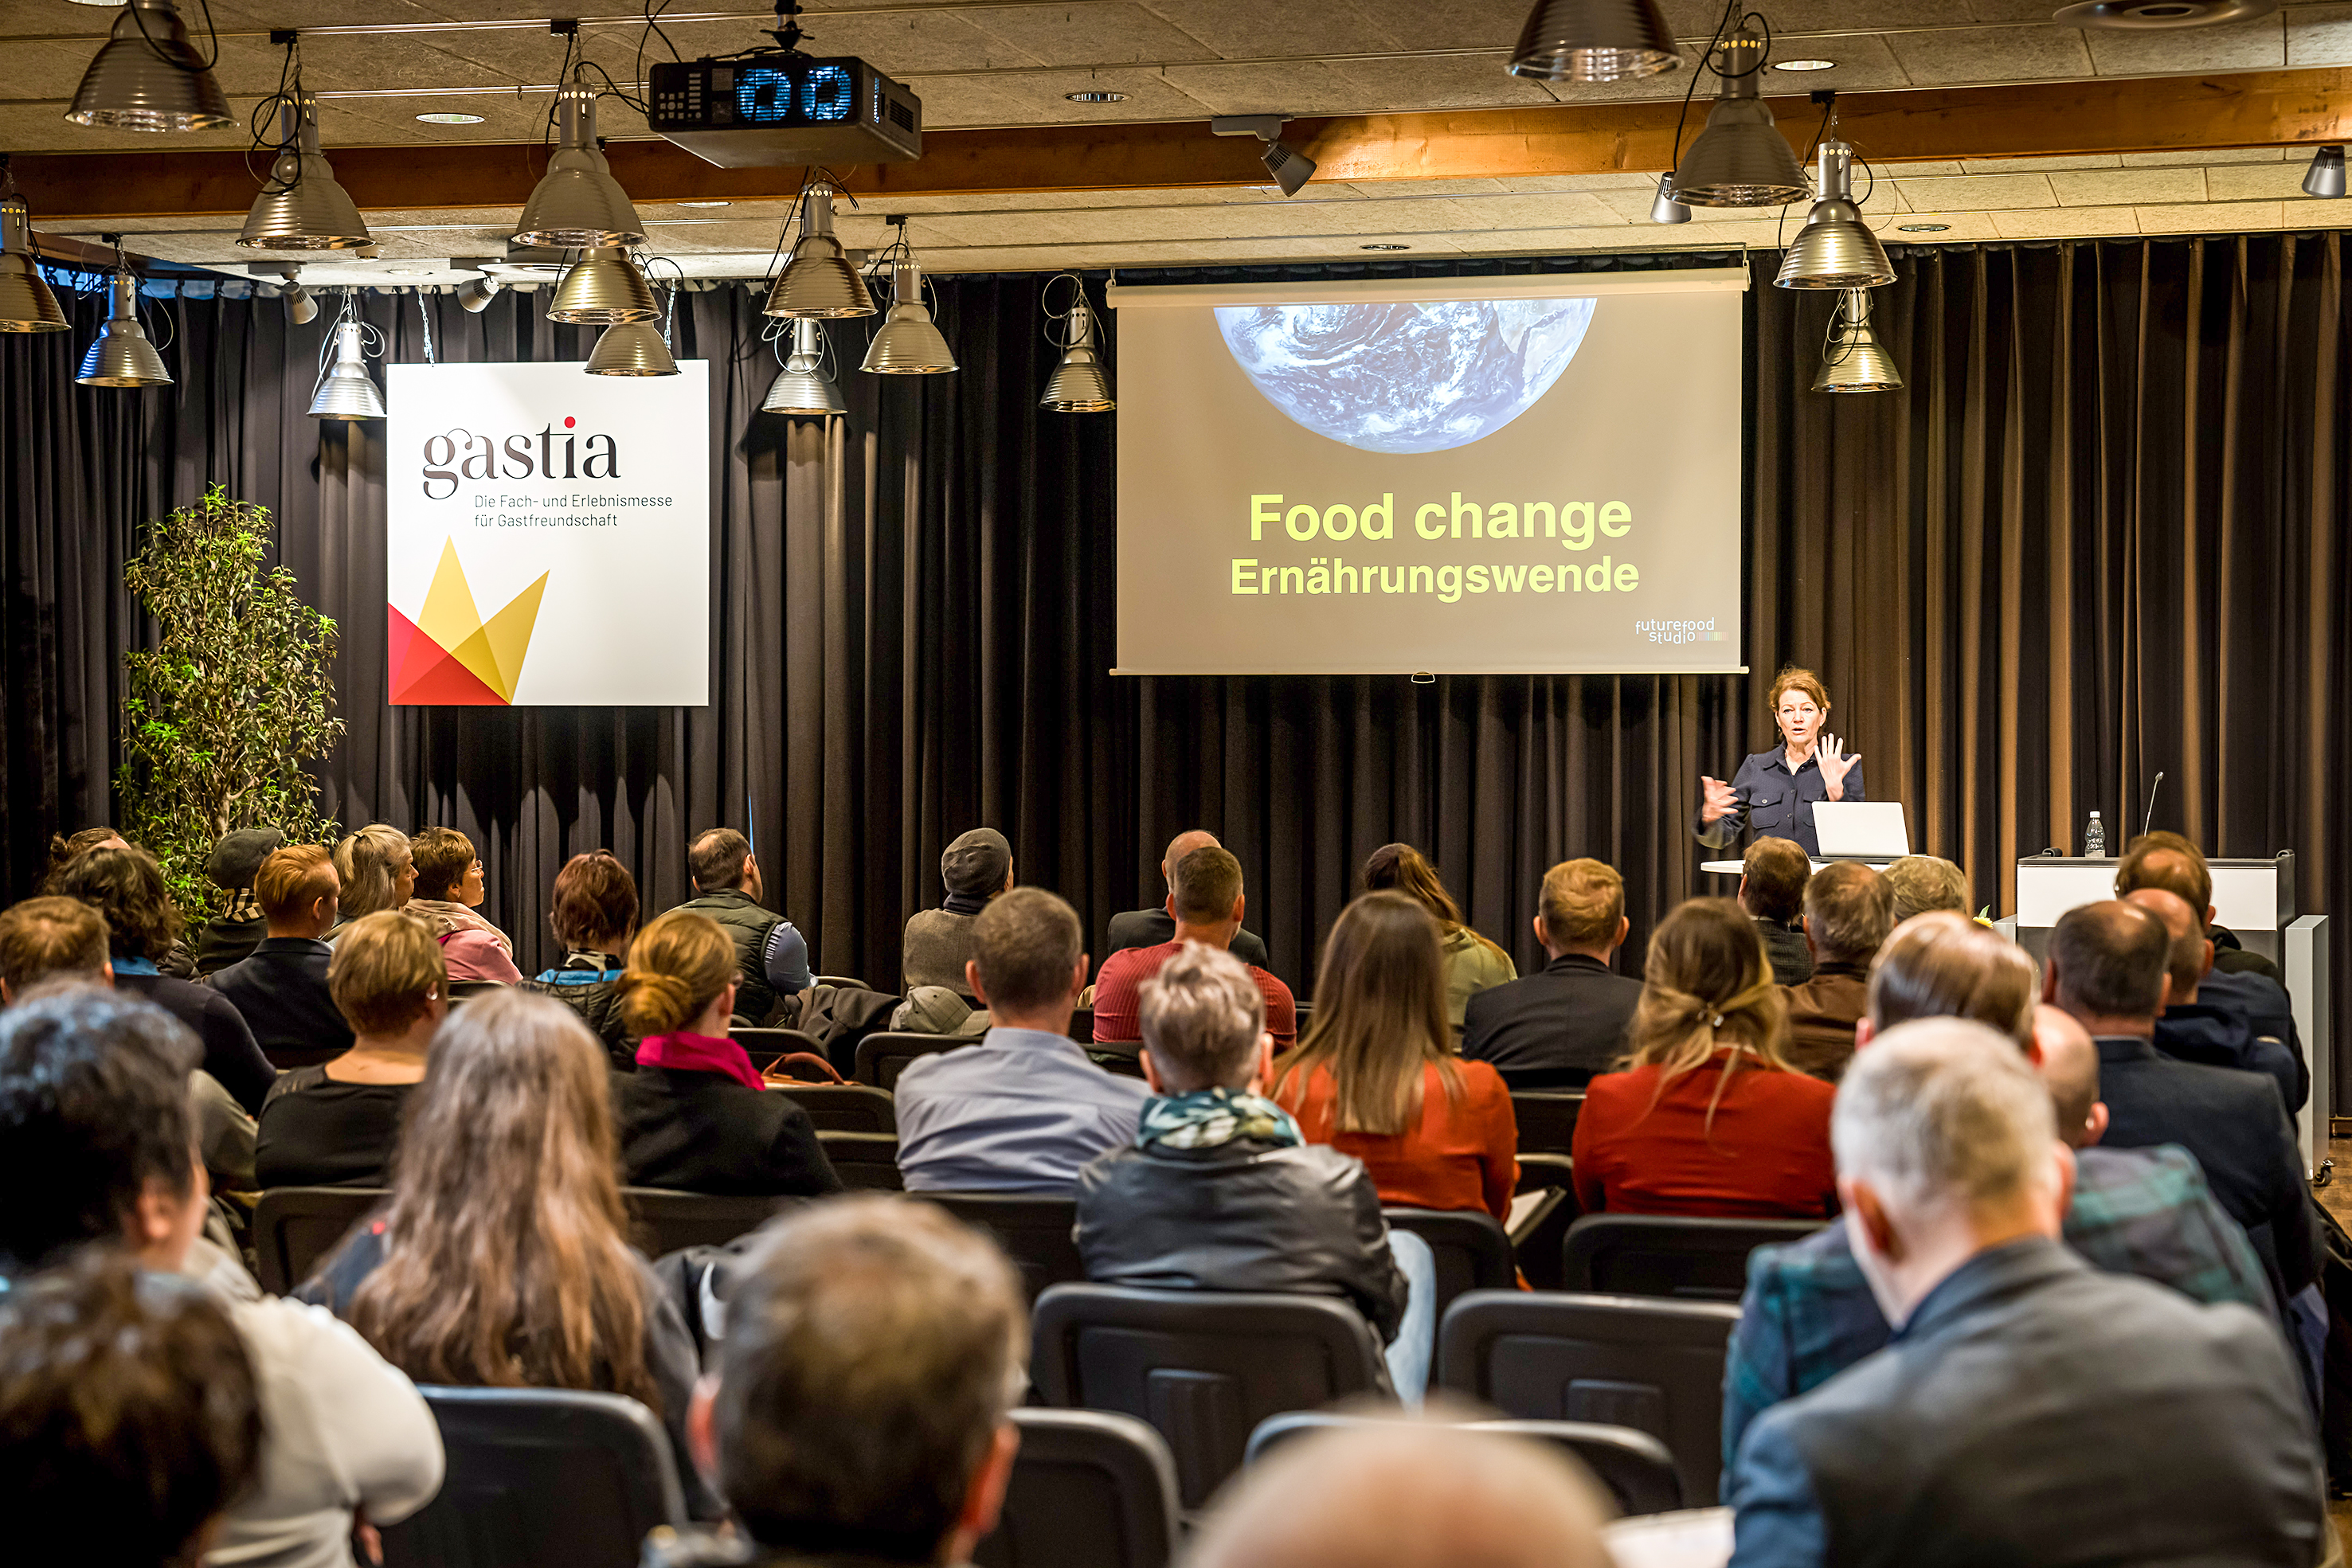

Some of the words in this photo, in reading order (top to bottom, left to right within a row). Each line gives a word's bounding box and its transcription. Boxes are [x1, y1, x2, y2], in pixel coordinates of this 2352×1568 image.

[422, 416, 621, 500] gastia
[475, 495, 495, 508] Die
[500, 495, 538, 508] Fach-
[542, 495, 567, 508] und
[572, 494, 673, 508] Erlebnismesse
[475, 514, 494, 527] für
[498, 513, 618, 527] Gastfreundschaft
[1250, 492, 1395, 542] Food
[1415, 491, 1633, 551] change
[1231, 555, 1640, 604] Ernährungswende
[1635, 616, 1715, 635] futurefood
[1649, 631, 1696, 644] studio
